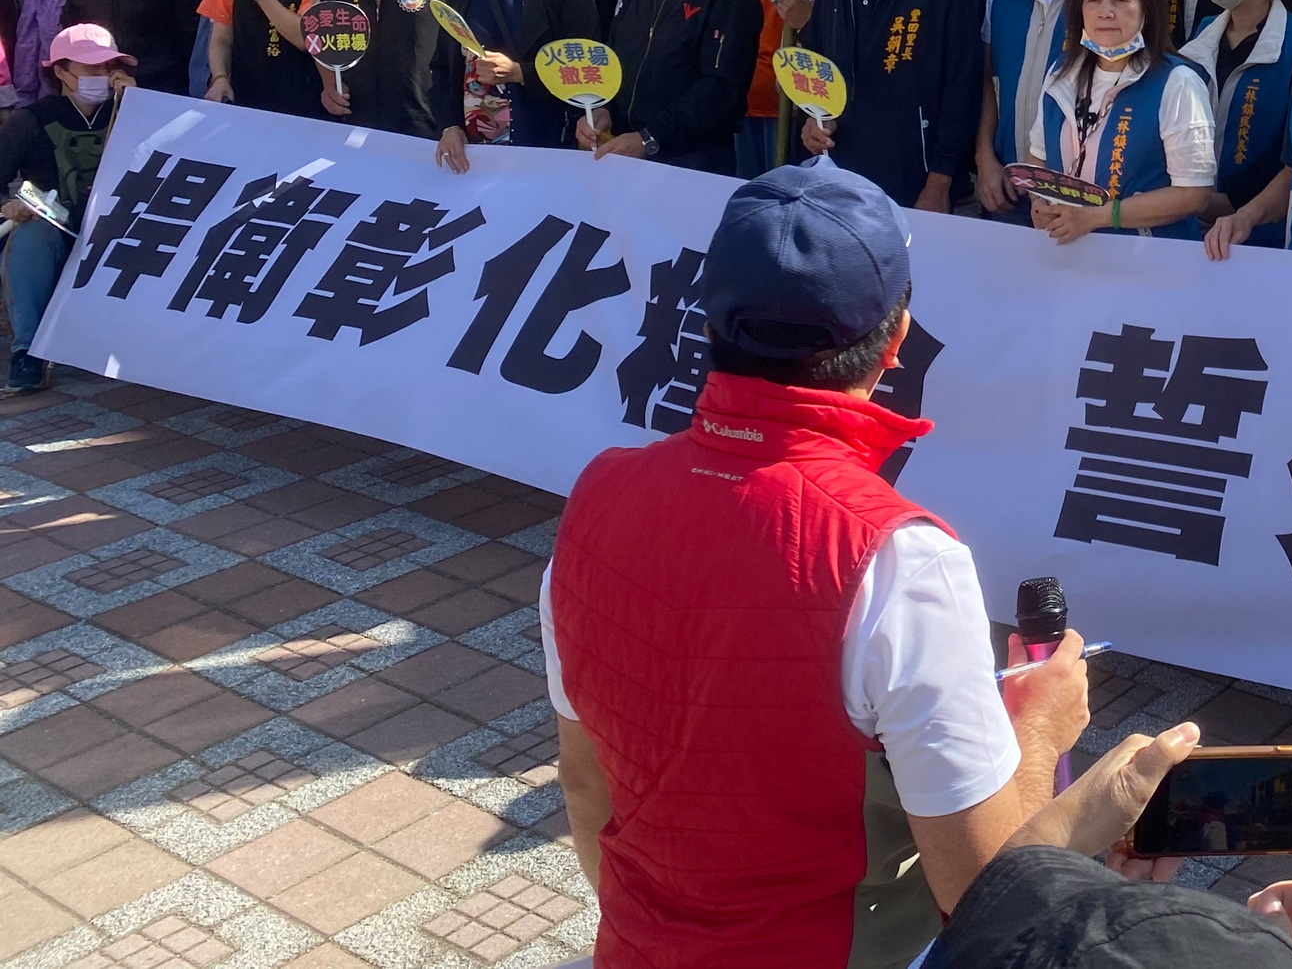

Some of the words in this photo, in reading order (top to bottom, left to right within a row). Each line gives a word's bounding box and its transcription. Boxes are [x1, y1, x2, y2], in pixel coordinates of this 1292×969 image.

[303, 8, 367, 32] 珍愛生命
[322, 33, 367, 51] 火葬場
[542, 43, 609, 66] 火葬場
[884, 16, 905, 74] 吳朝章
[558, 65, 604, 85] 撤案
[777, 51, 834, 83] 火葬場
[792, 71, 830, 99] 撤案
[1234, 78, 1259, 164] 二林鎮民代表會
[1108, 108, 1132, 201] 二林鎮民代表會
[712, 421, 764, 443] Columbia
